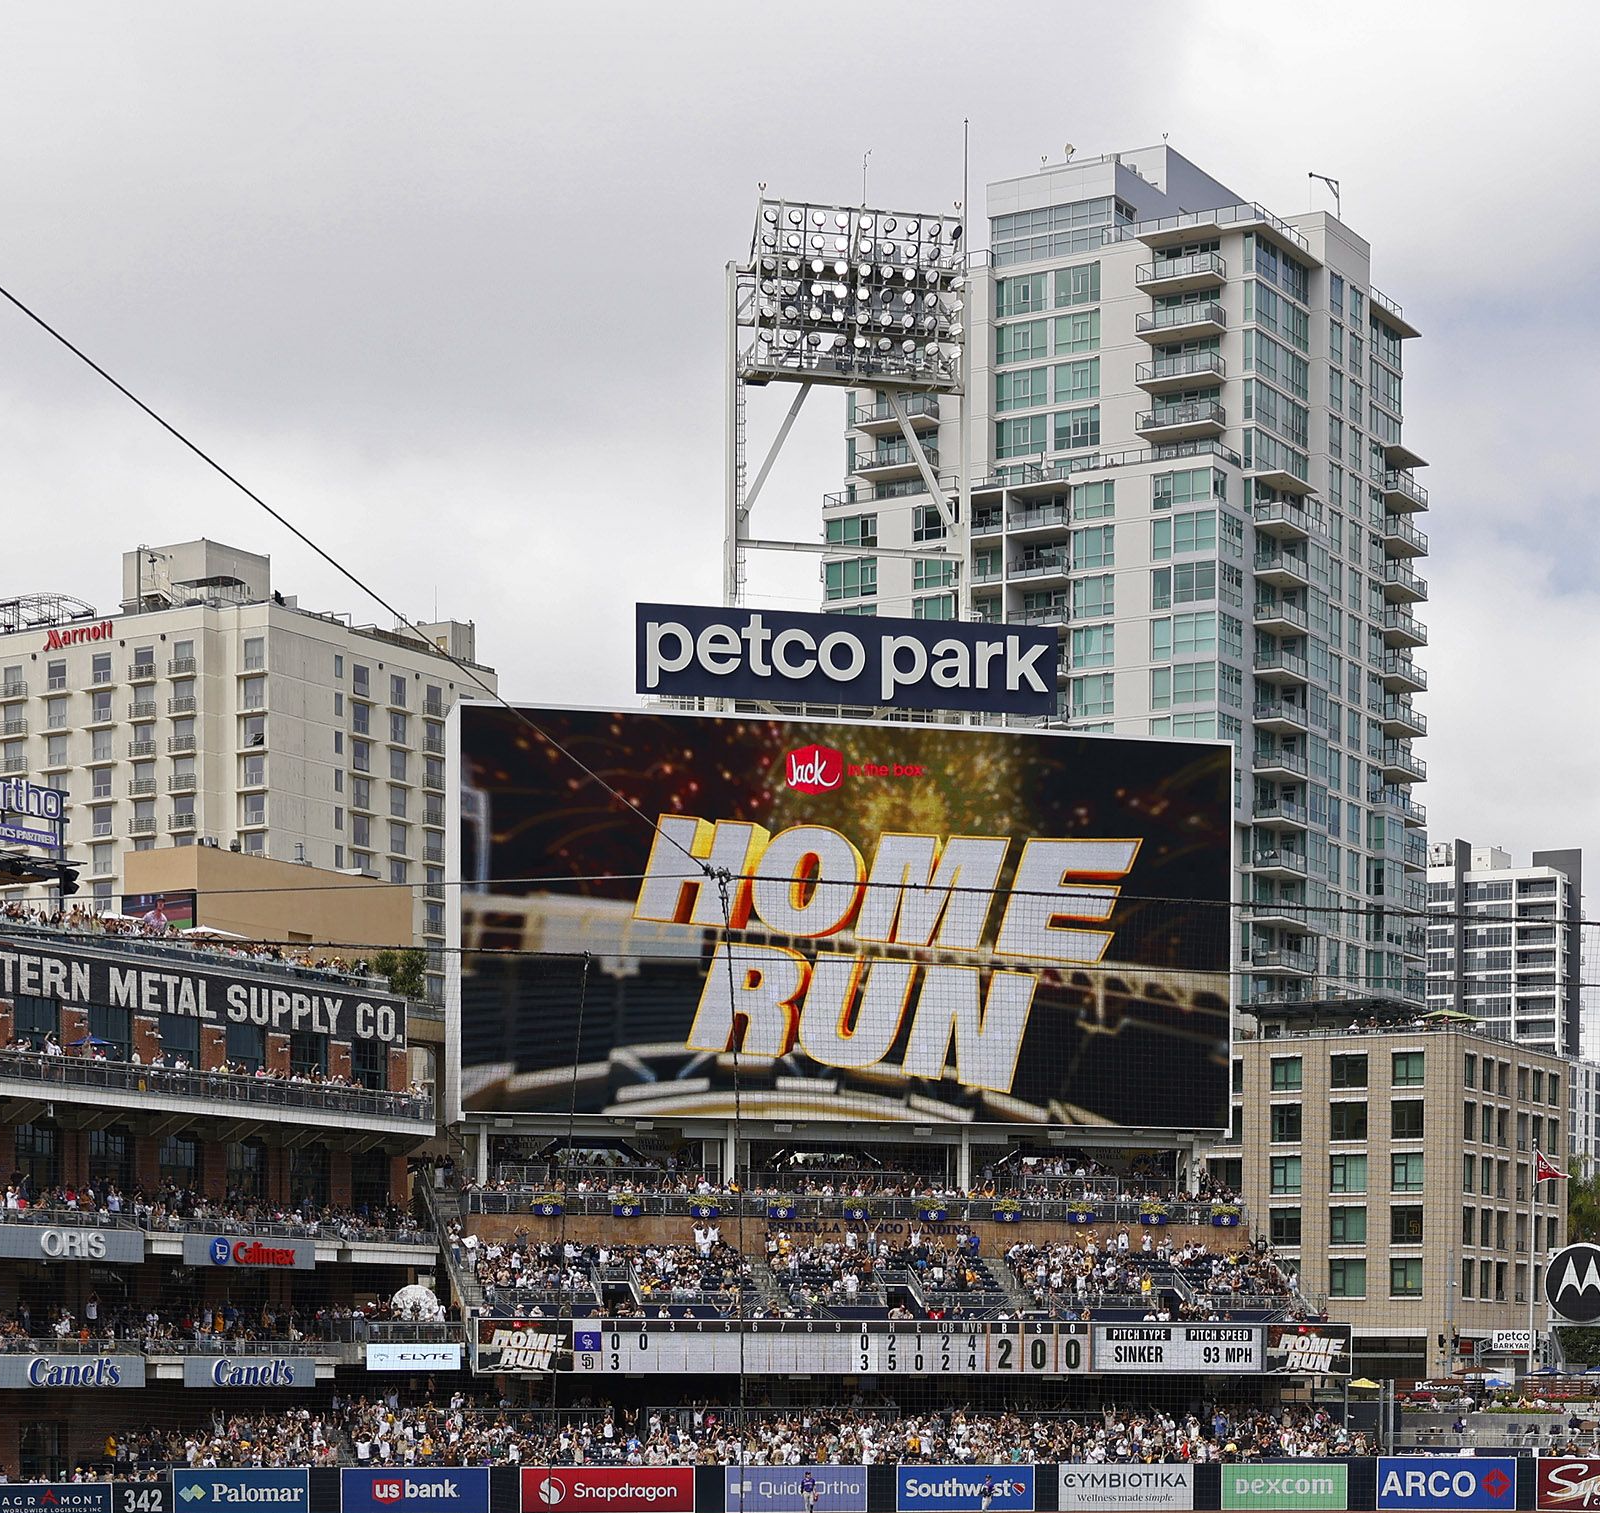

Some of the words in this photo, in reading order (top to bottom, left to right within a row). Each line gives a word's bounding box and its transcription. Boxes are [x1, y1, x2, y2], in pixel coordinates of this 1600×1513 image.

[43, 620, 113, 653] Marriott
[646, 614, 867, 689] petco
[881, 634, 1049, 701] park
[787, 744, 840, 788] Jack
[863, 763, 889, 777] the
[893, 763, 923, 778] box
[15, 829, 56, 846] PARTNER
[633, 813, 1143, 963] HOME
[108, 966, 217, 1020] METAL
[226, 983, 343, 1035] SUPPLY
[356, 1002, 403, 1044] CO.
[685, 942, 1038, 1093] RUN
[40, 1230, 106, 1258] ORIS
[232, 1241, 296, 1265] Calimax
[937, 1323, 955, 1334] LOB
[962, 1323, 983, 1334] MVR
[1112, 1329, 1142, 1340] PITCH
[1143, 1329, 1166, 1340] TYPE
[1190, 1329, 1218, 1341] PITCH
[1219, 1330, 1249, 1342] SPEED
[1497, 1331, 1531, 1343] petco
[491, 1329, 568, 1352] HOME
[611, 1333, 620, 1351] 0
[638, 1333, 649, 1351] 0
[860, 1334, 869, 1351] 0
[887, 1334, 897, 1351] 2
[916, 1335, 922, 1351] 1
[941, 1335, 950, 1351] 2
[967, 1335, 977, 1351] 4
[1278, 1333, 1345, 1357] HOME
[397, 1353, 454, 1361] ELYTE
[499, 1349, 551, 1371] RUN
[610, 1354, 620, 1371] 3
[860, 1354, 869, 1371] 3
[887, 1354, 897, 1371] 5
[915, 1354, 924, 1371] 0
[941, 1354, 950, 1371] 2
[967, 1354, 977, 1371] 4
[997, 1339, 1013, 1370] 2
[1031, 1339, 1047, 1370] 0
[1065, 1339, 1081, 1370] 0
[1114, 1345, 1163, 1364] SINKER
[1203, 1346, 1220, 1364] 93
[1225, 1347, 1252, 1364] MPH
[1286, 1353, 1333, 1372] RUN
[27, 1357, 122, 1387] Canel's
[212, 1358, 296, 1387] Canel's
[374, 1482, 400, 1498] us
[905, 1478, 1012, 1498] Southwst
[1063, 1472, 1187, 1488] CYMBIOTIKA
[1380, 1470, 1477, 1498] ARCO
[124, 1489, 163, 1513] 342
[211, 1484, 304, 1502] Palomar
[573, 1482, 678, 1501] Snapdragon
[1077, 1493, 1116, 1502] Wellness
[1118, 1493, 1144, 1502] made
[1144, 1493, 1175, 1504] simple.
